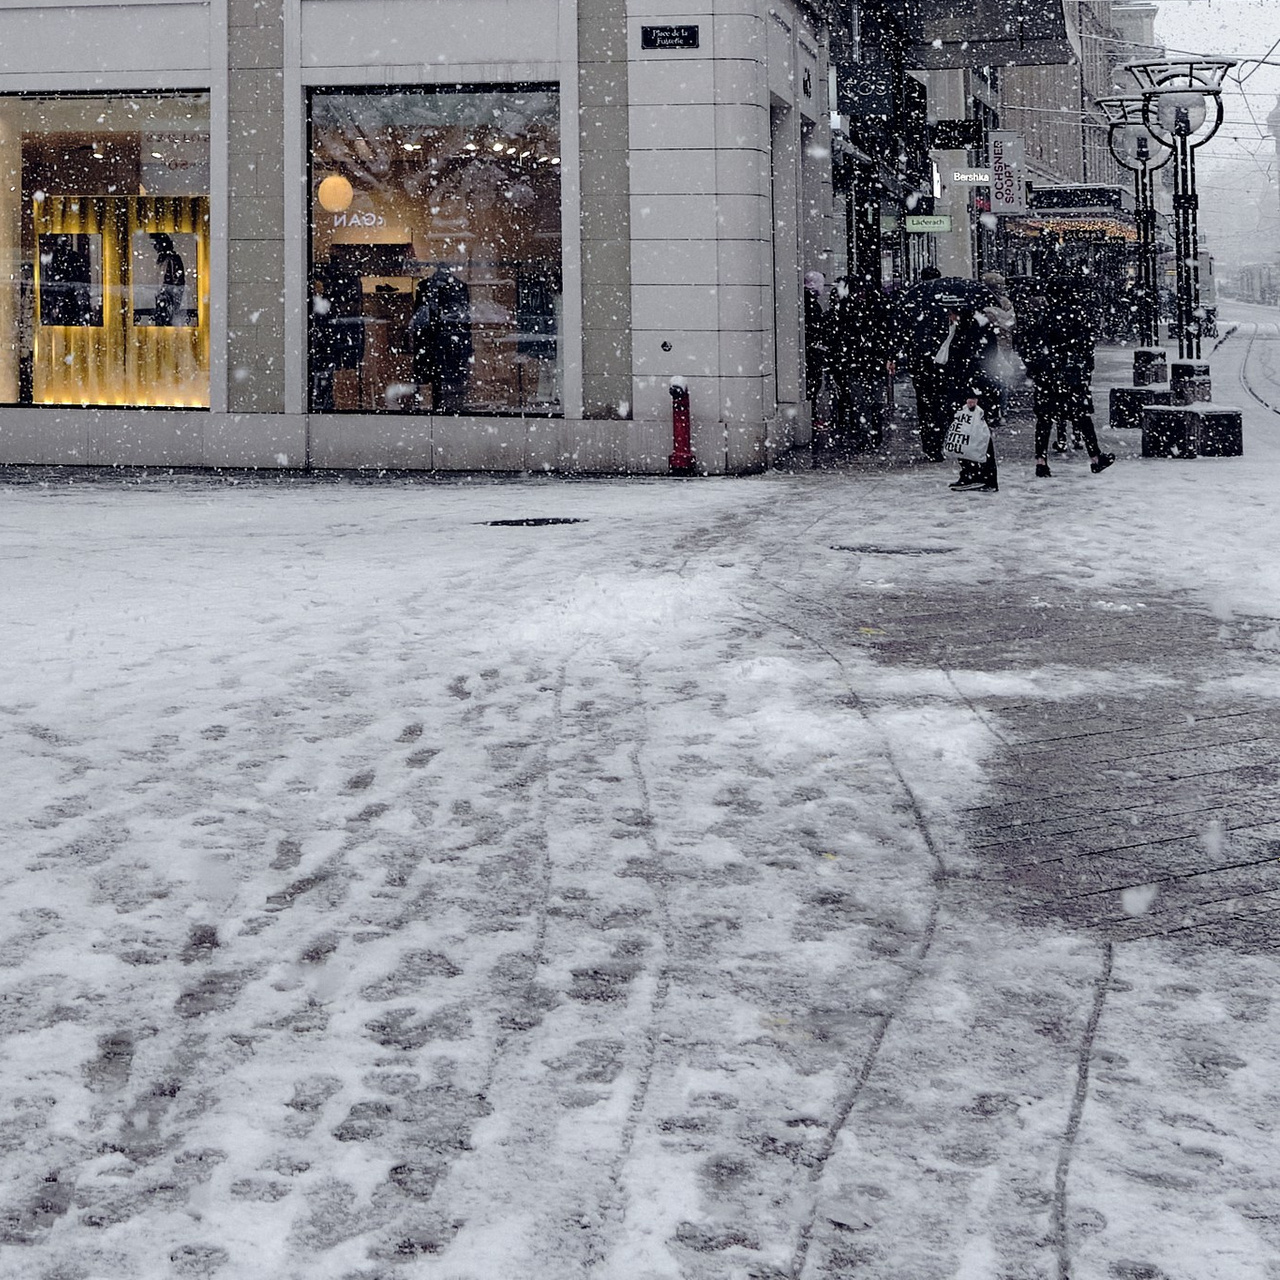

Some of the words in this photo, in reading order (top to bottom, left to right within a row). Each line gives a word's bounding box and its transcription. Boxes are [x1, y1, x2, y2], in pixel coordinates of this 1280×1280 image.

[652, 29, 670, 38] Place
[671, 28, 680, 37] de
[841, 80, 888, 97] COS
[953, 172, 990, 181] Bershka
[993, 140, 1004, 200] OCHSNER
[1004, 163, 1015, 204] SPORT
